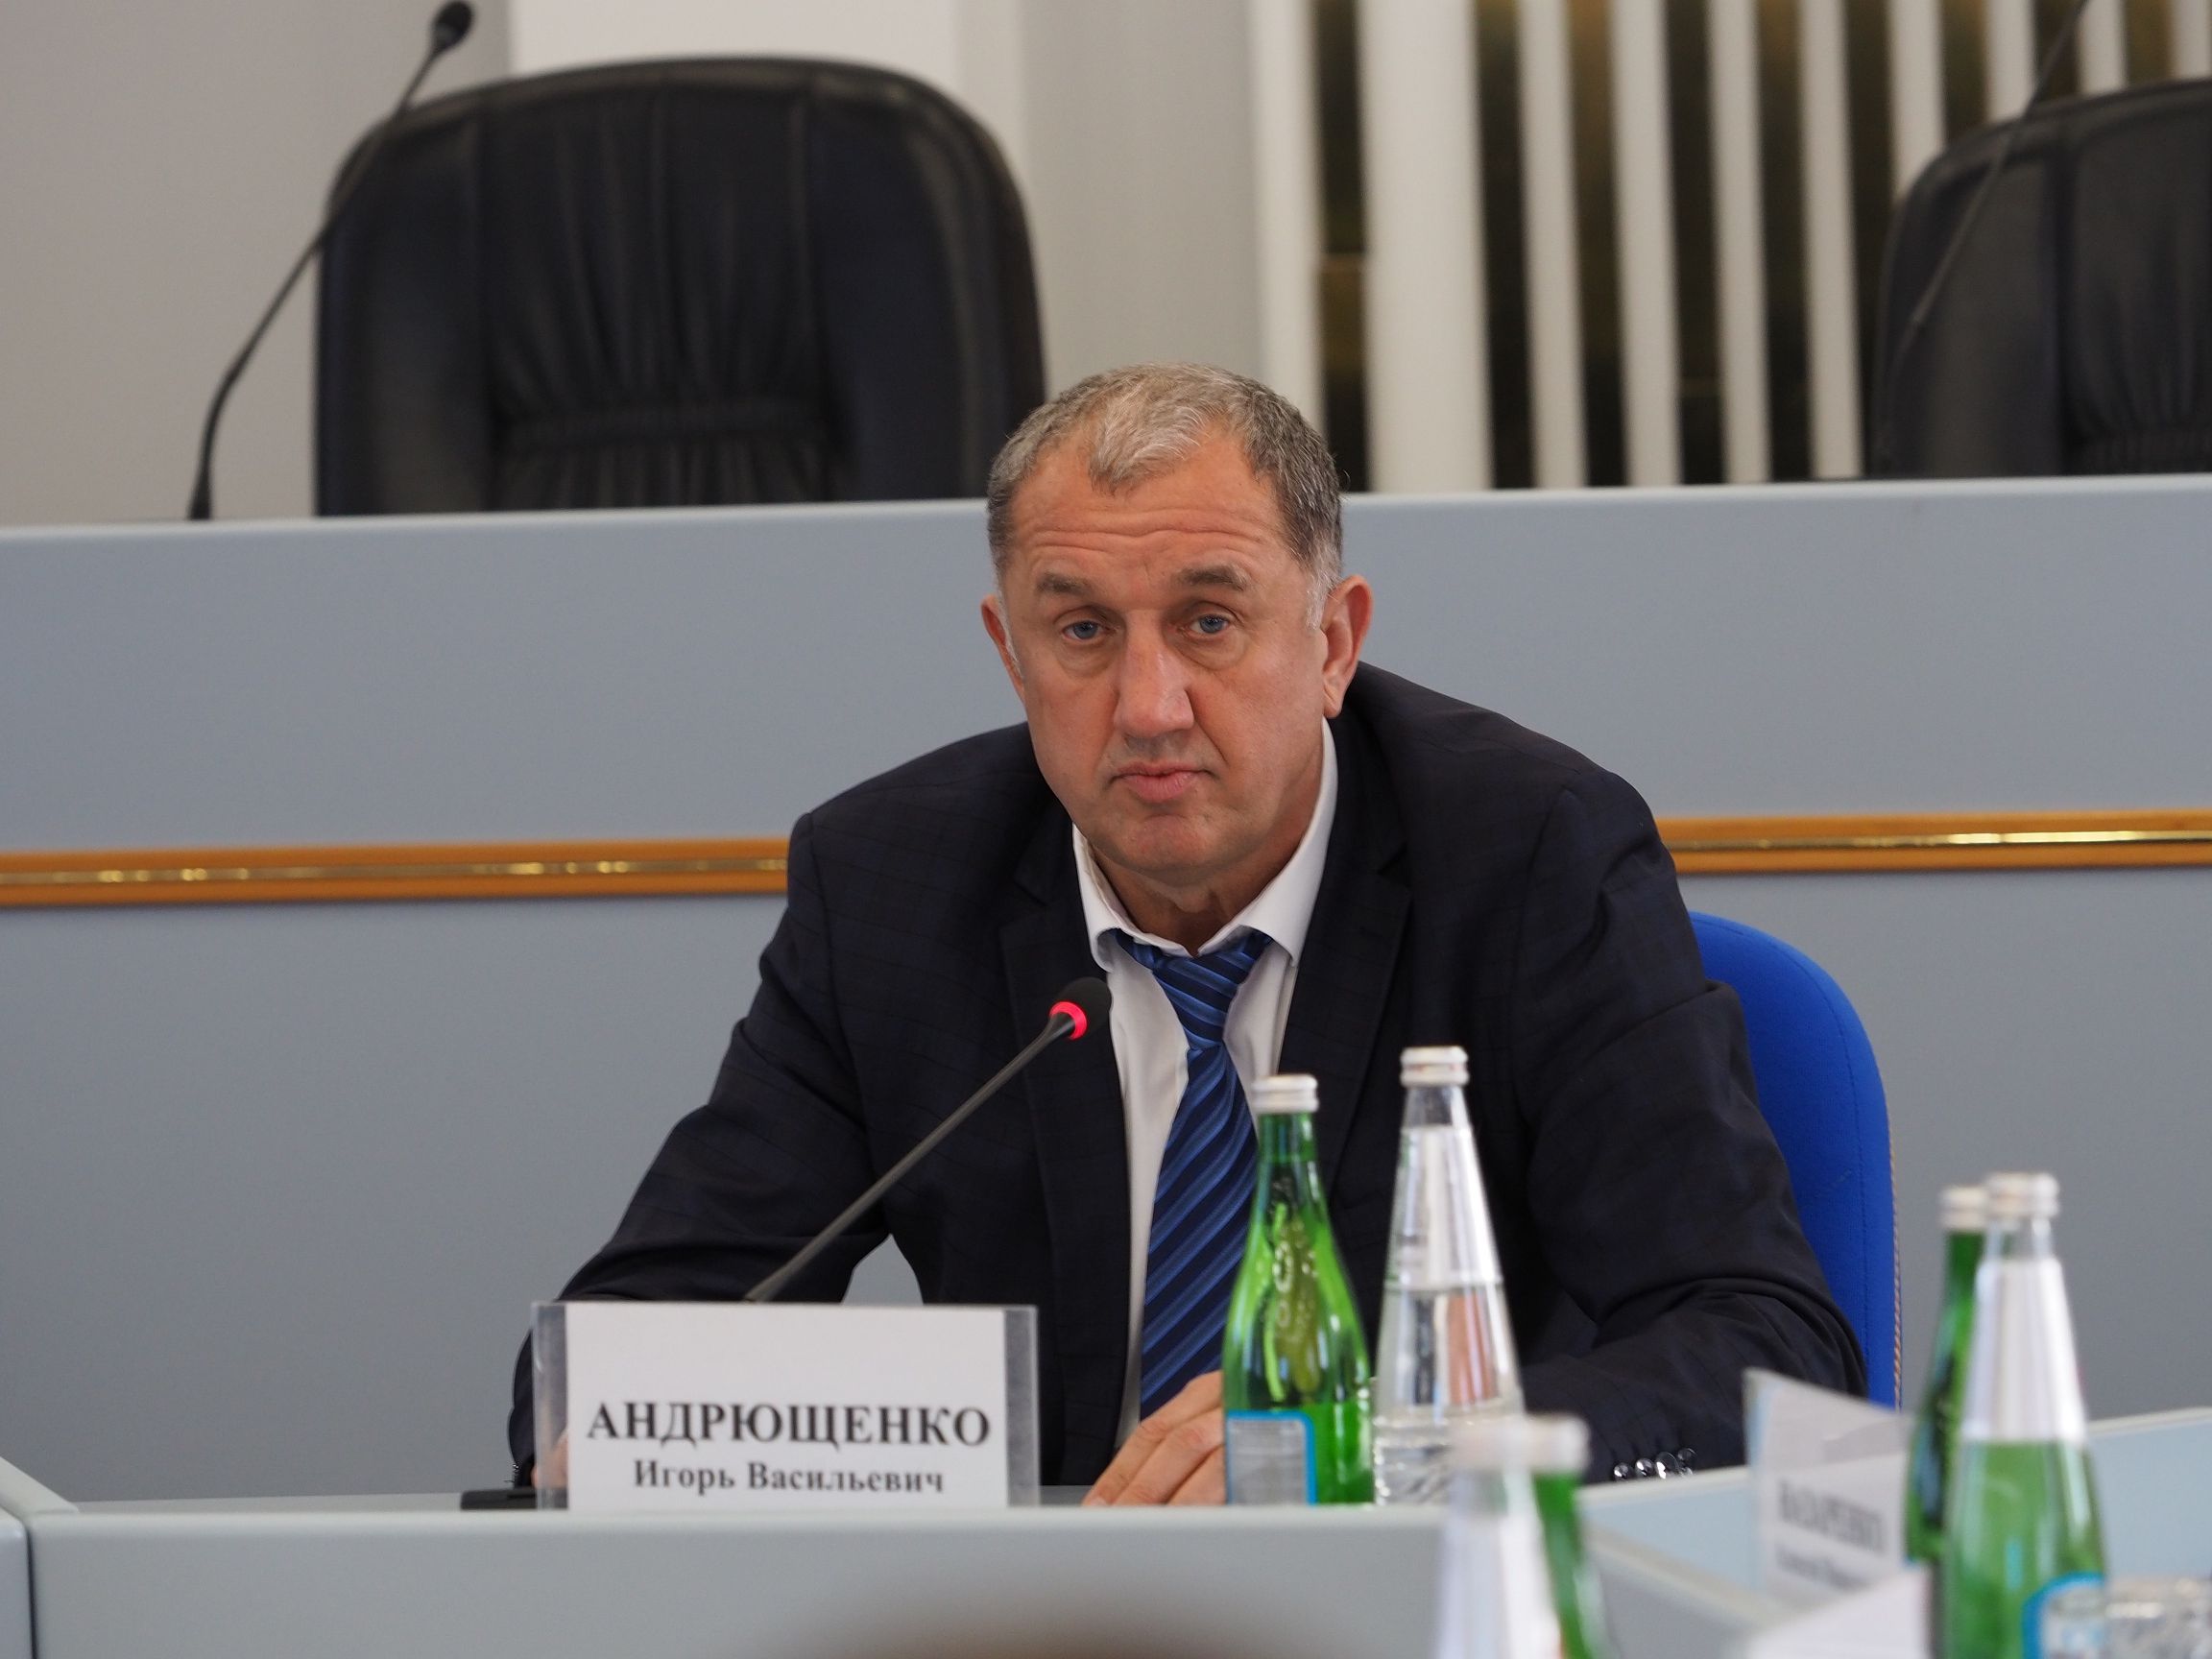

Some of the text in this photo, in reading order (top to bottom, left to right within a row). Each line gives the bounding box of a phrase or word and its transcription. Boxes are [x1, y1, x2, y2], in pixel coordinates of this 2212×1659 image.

[587, 1402, 991, 1447] АНДРЮЩЕНКО
[634, 1459, 944, 1495] Игорь Васильевич
